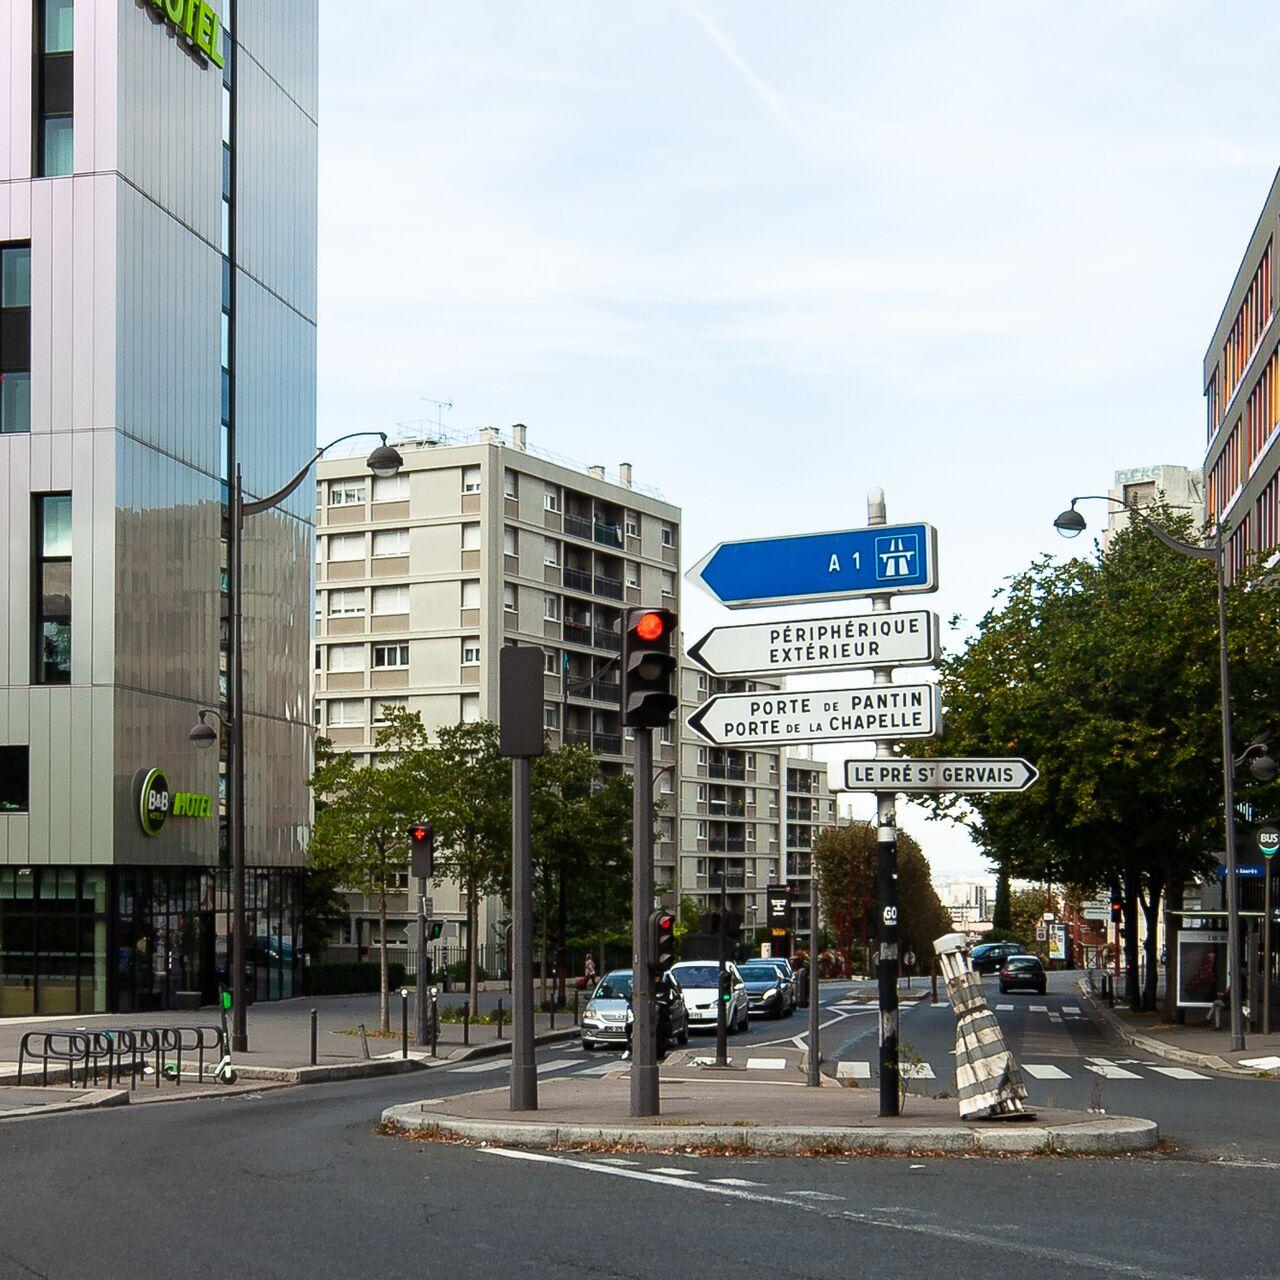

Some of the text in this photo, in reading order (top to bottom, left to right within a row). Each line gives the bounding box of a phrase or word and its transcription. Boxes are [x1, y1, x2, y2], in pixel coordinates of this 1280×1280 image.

[828, 554, 840, 572] A
[770, 618, 920, 644] PÉRIPHÉRIQUE
[770, 640, 880, 664] EXTÉRIEUR
[750, 692, 923, 717] PORTE DE PANTIN
[724, 712, 923, 737] PORTE DE LA CHAPELLE
[855, 767, 874, 783] LE
[880, 764, 913, 783] PRÉ
[942, 767, 1014, 783] GERVAIS
[148, 790, 169, 811] B&B
[173, 792, 212, 817] HOTEL
[1260, 833, 1279, 843] BUS
[883, 906, 897, 919] GO
